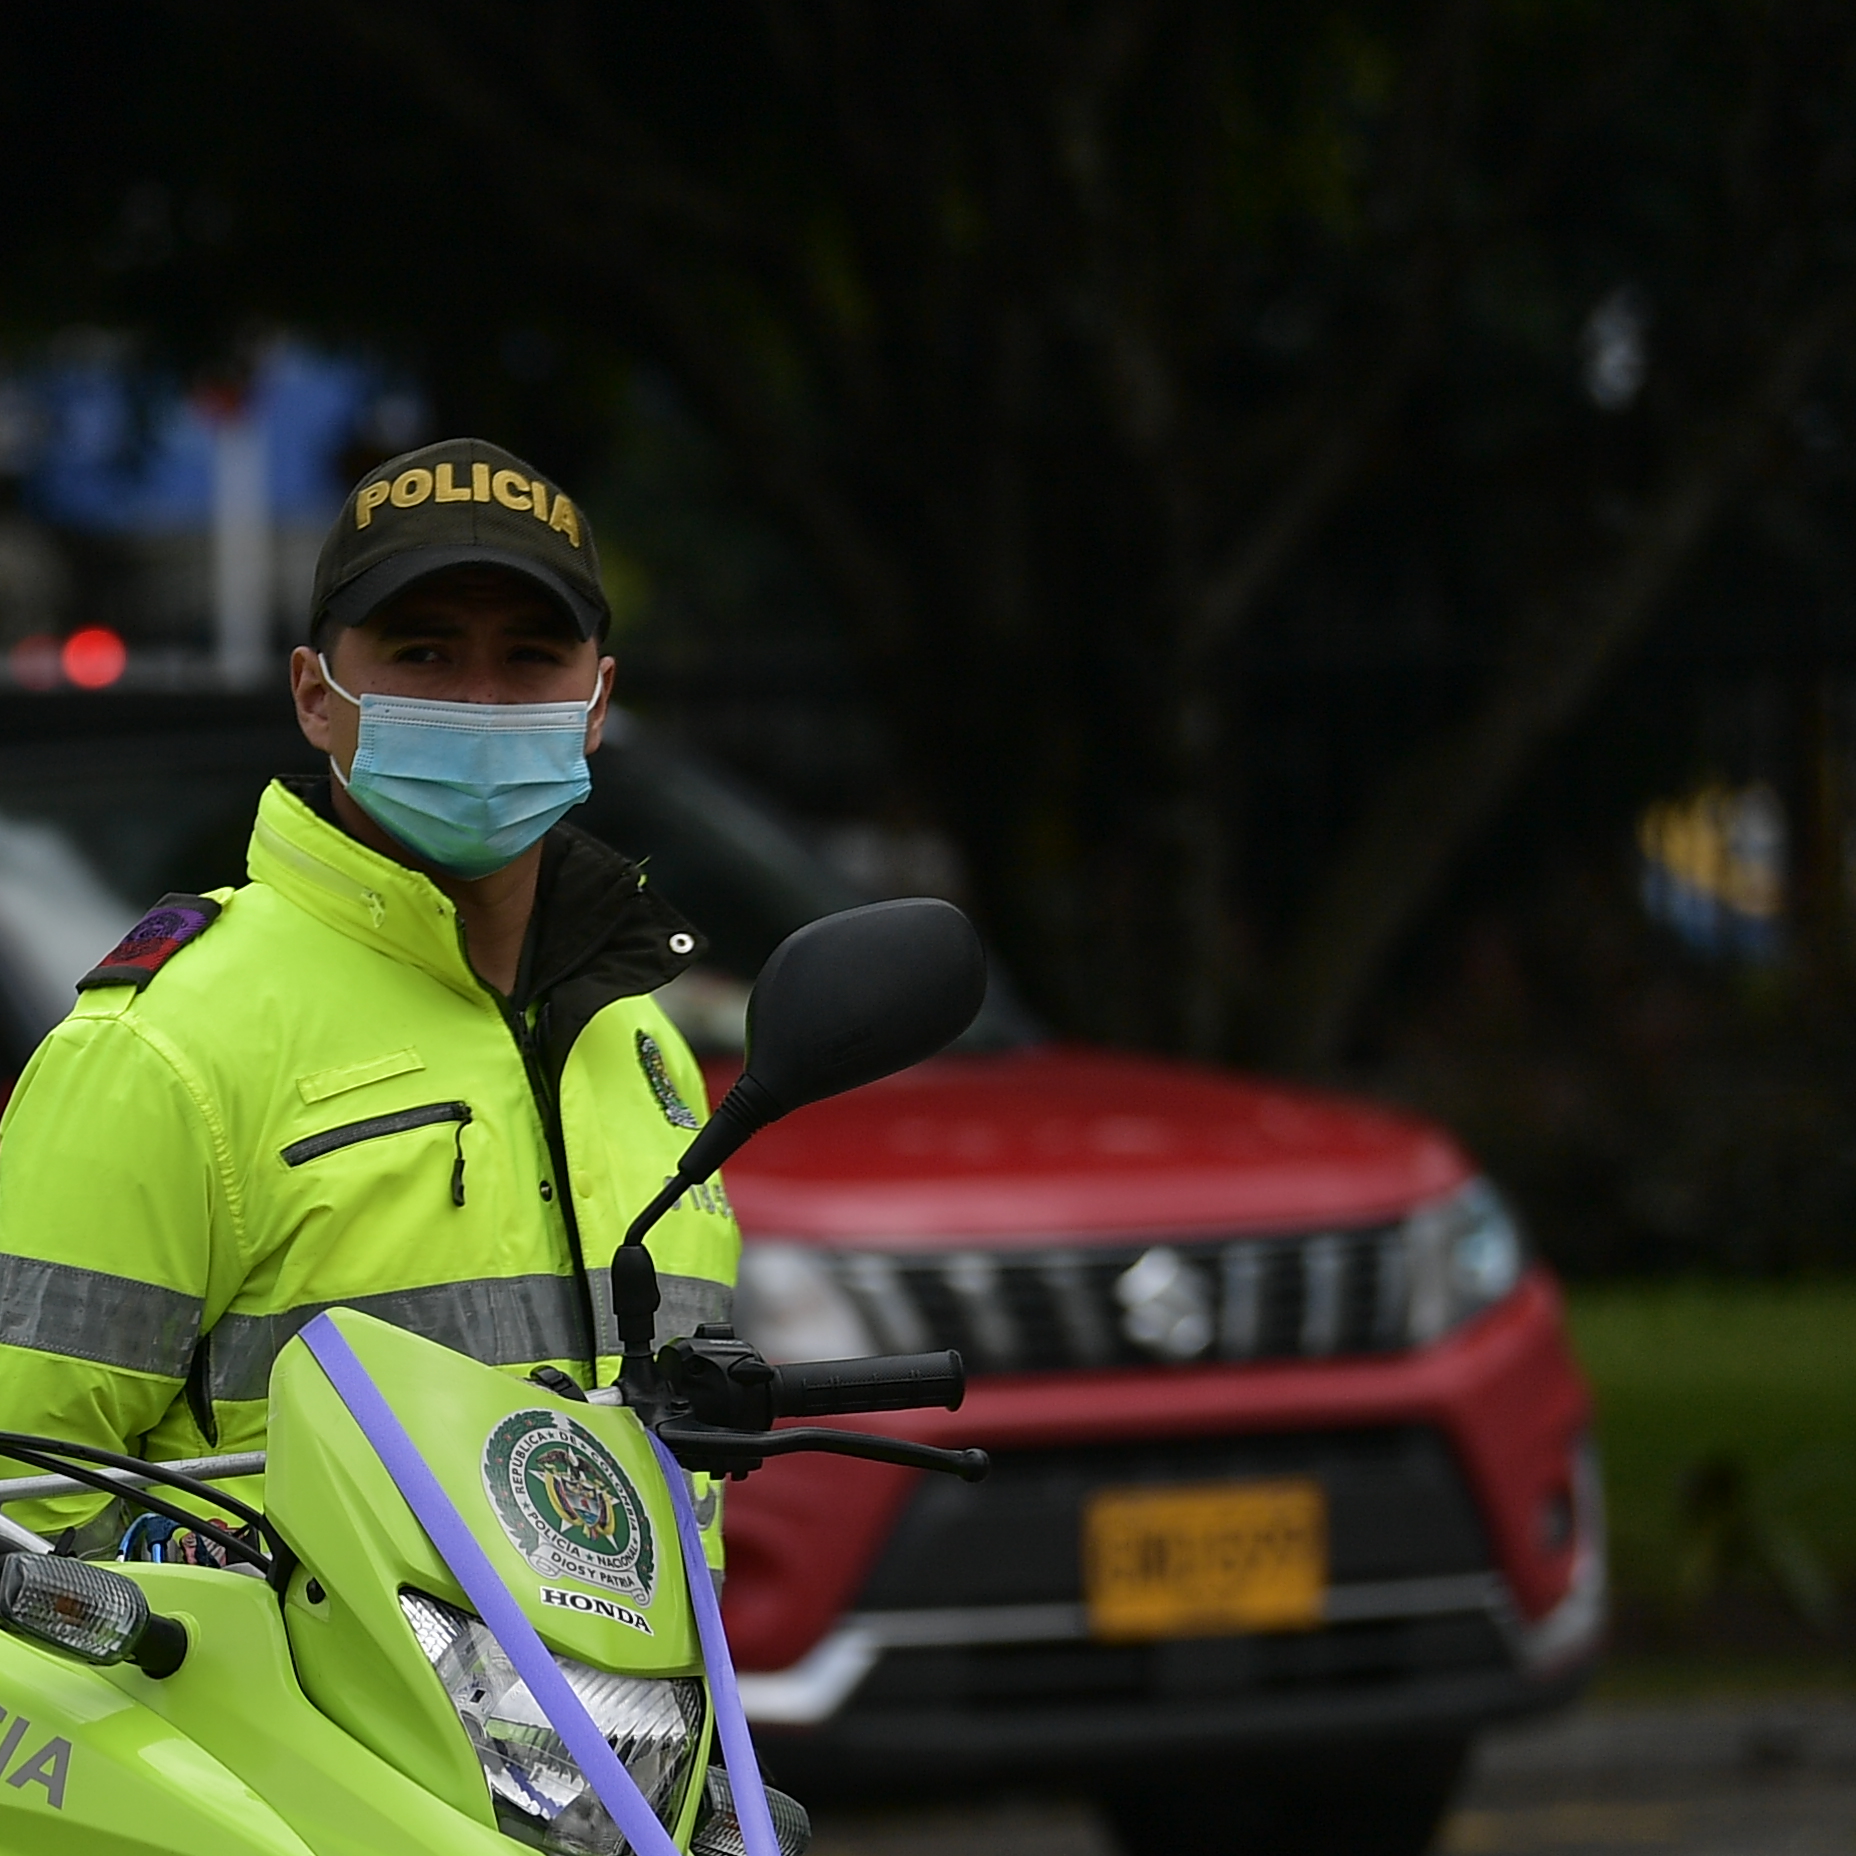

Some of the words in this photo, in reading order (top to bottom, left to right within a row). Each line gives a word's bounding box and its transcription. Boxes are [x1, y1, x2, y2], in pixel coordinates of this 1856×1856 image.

[354, 461, 583, 548] POLICIA
[559, 1431, 578, 1447] DE
[591, 1451, 638, 1532] COLOMBIA
[597, 1543, 638, 1569] NACIONAL
[600, 1571, 636, 1588] PATRIA
[542, 1588, 653, 1634] HONDA
